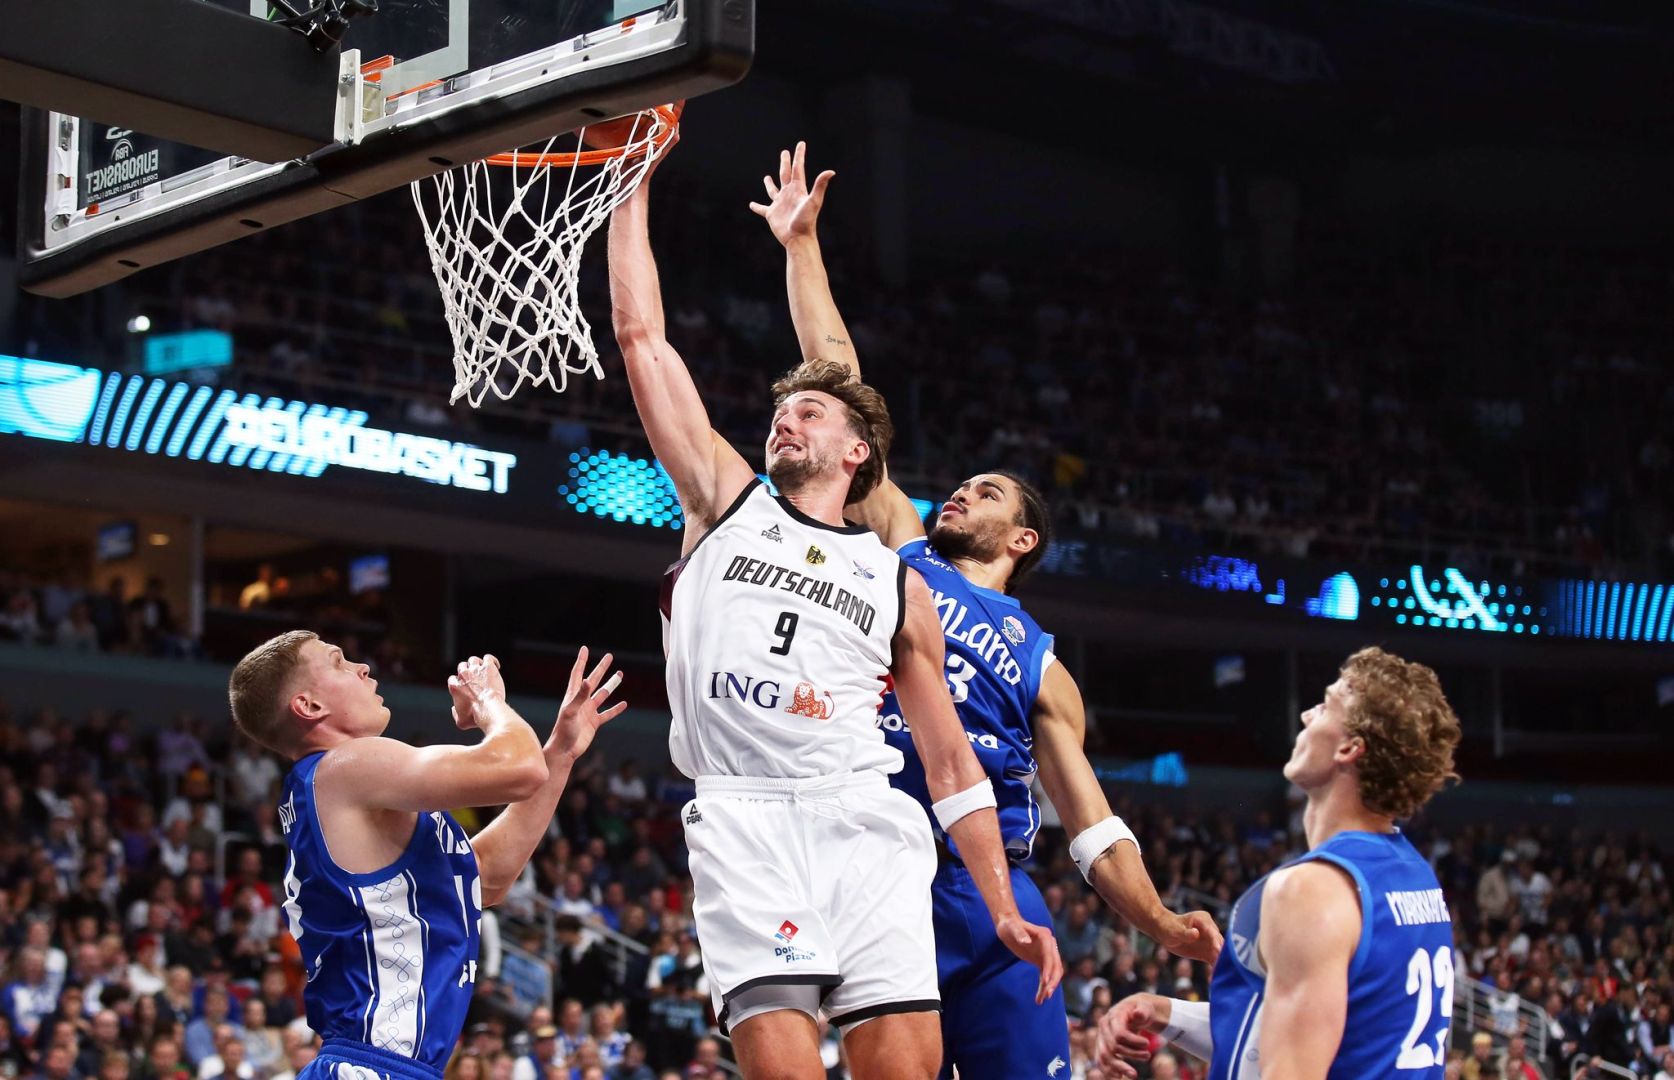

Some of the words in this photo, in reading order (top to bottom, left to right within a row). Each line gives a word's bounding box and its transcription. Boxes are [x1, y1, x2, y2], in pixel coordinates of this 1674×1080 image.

[223, 402, 517, 494] #EUROBASKET
[761, 530, 783, 544] PEAK
[722, 555, 876, 637] DEUTSCHLAND
[769, 611, 799, 657] 9
[708, 671, 781, 709] ING
